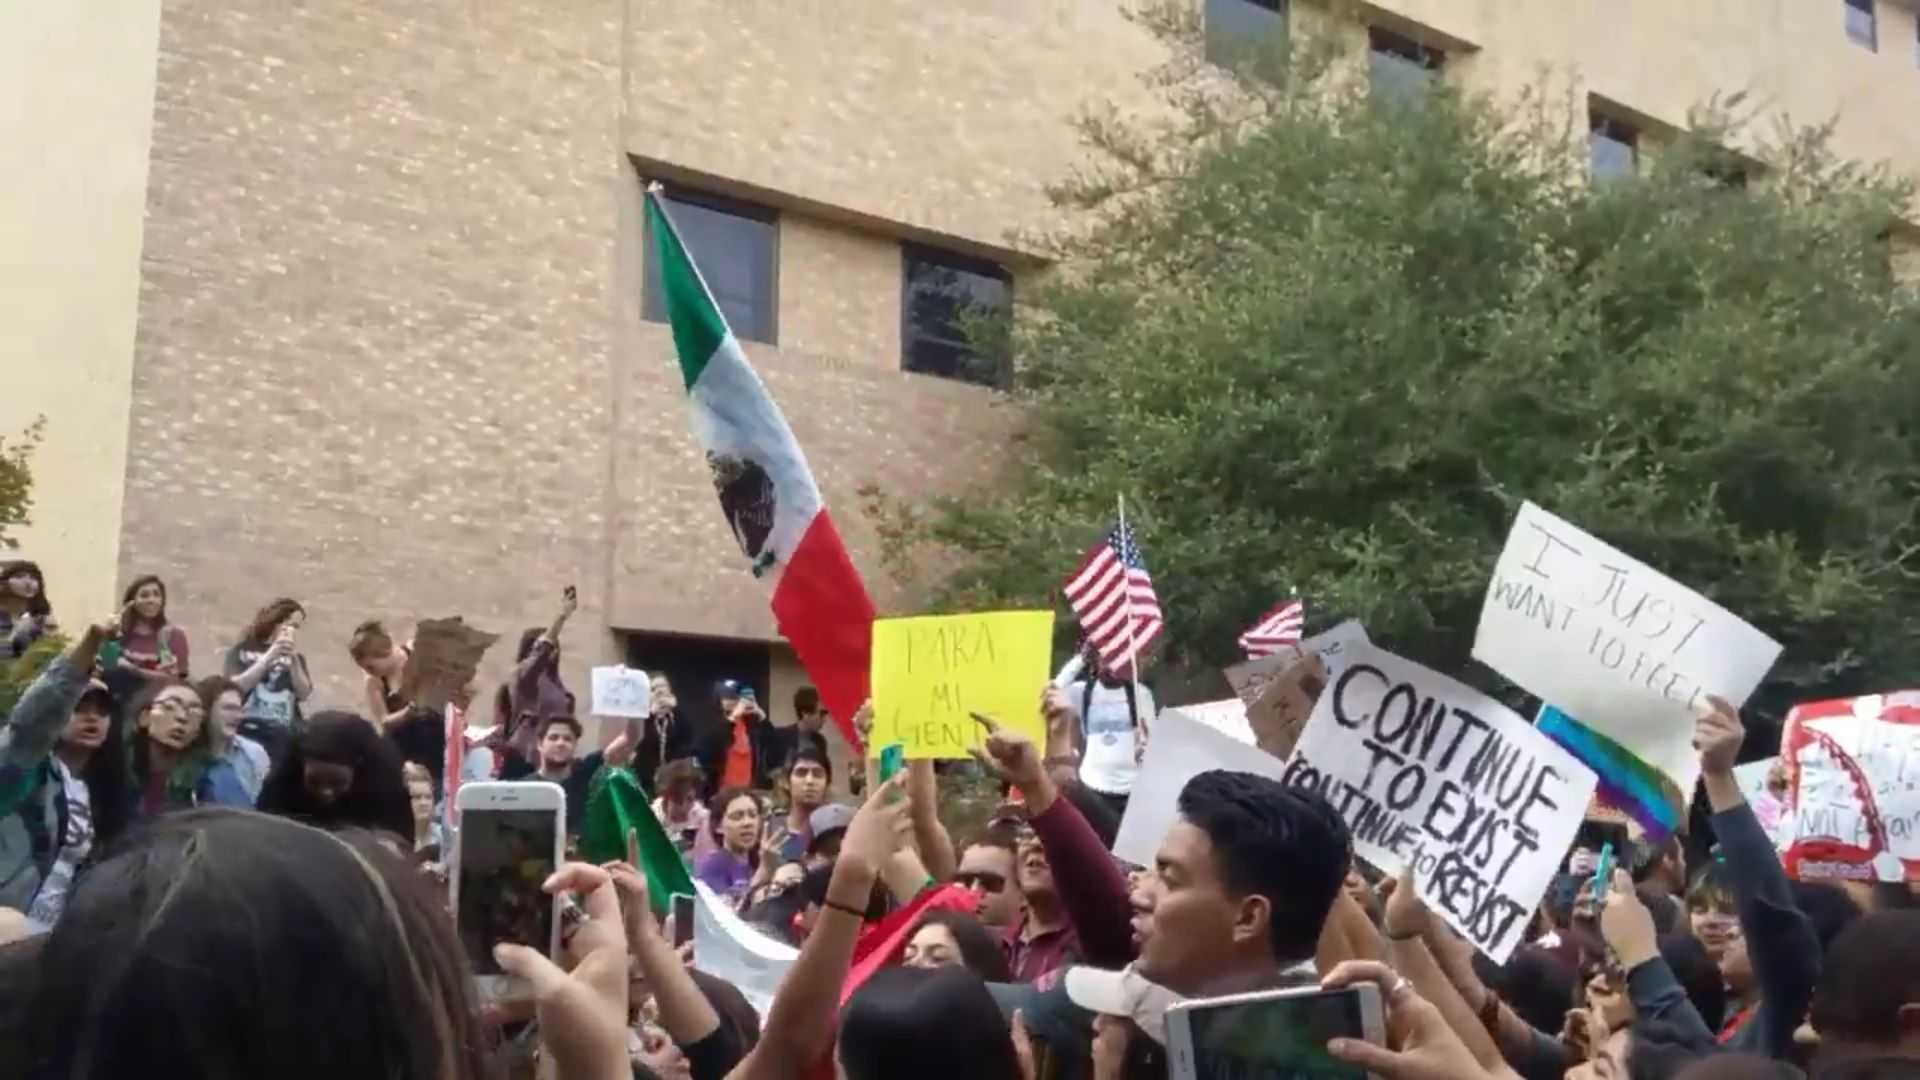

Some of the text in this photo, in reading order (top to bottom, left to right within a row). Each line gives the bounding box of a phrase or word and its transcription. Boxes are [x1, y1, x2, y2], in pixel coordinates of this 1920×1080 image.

[1495, 581, 1578, 631] WANT
[1522, 520, 1705, 654] I JUST
[906, 621, 996, 673] PARA
[929, 681, 962, 716] MI
[1332, 663, 1568, 840] CONTINUE
[1362, 738, 1540, 887] TO EXIST
[1425, 851, 1528, 951] RESIST
